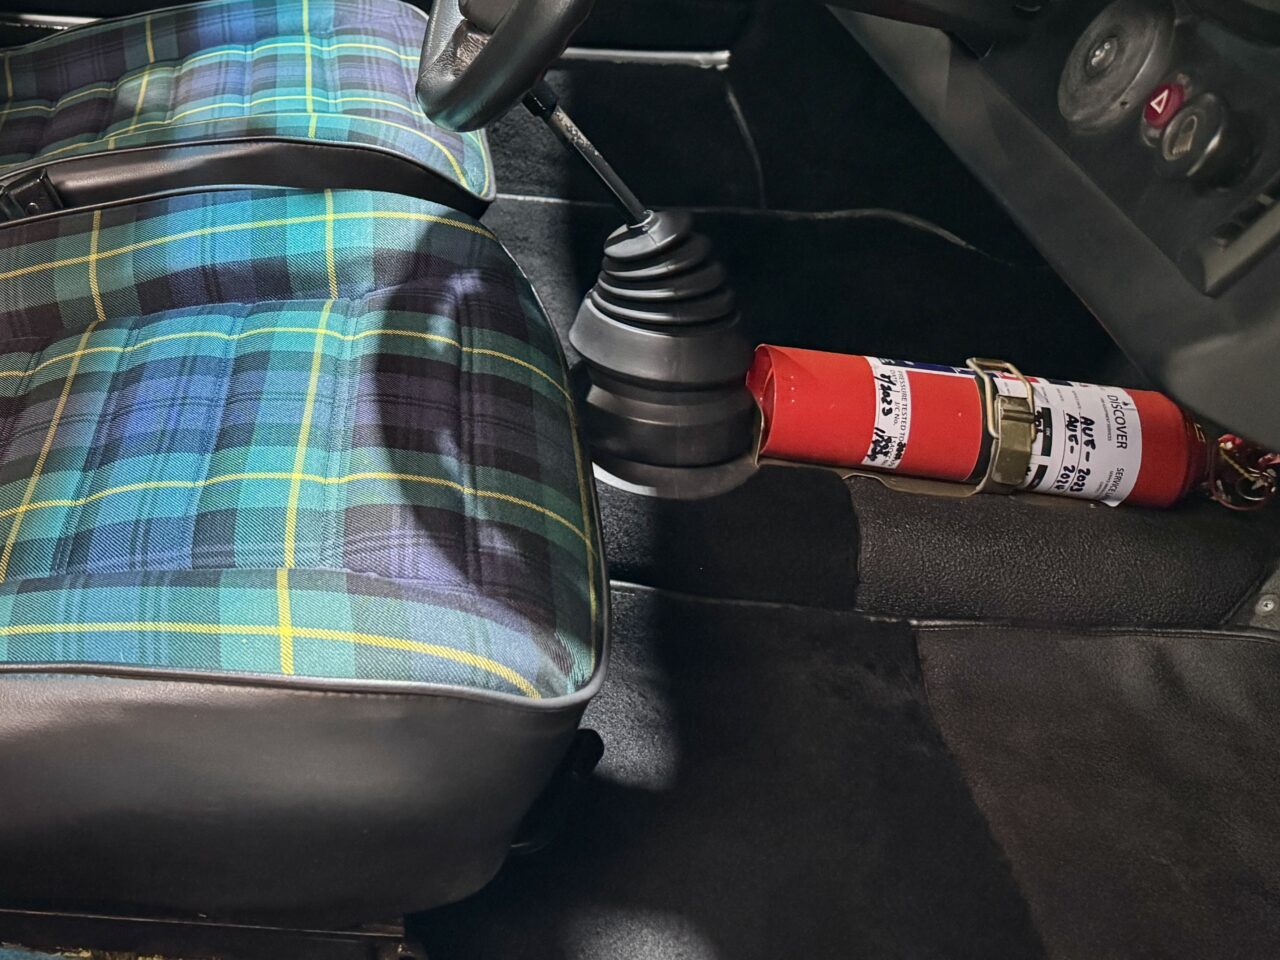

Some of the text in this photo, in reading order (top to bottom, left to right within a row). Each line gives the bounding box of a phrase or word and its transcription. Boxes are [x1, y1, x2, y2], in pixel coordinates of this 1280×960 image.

[898, 371, 907, 401] PRESSURE
[1107, 395, 1128, 449] DISCOVER
[1109, 468, 1124, 492] SERVICE
